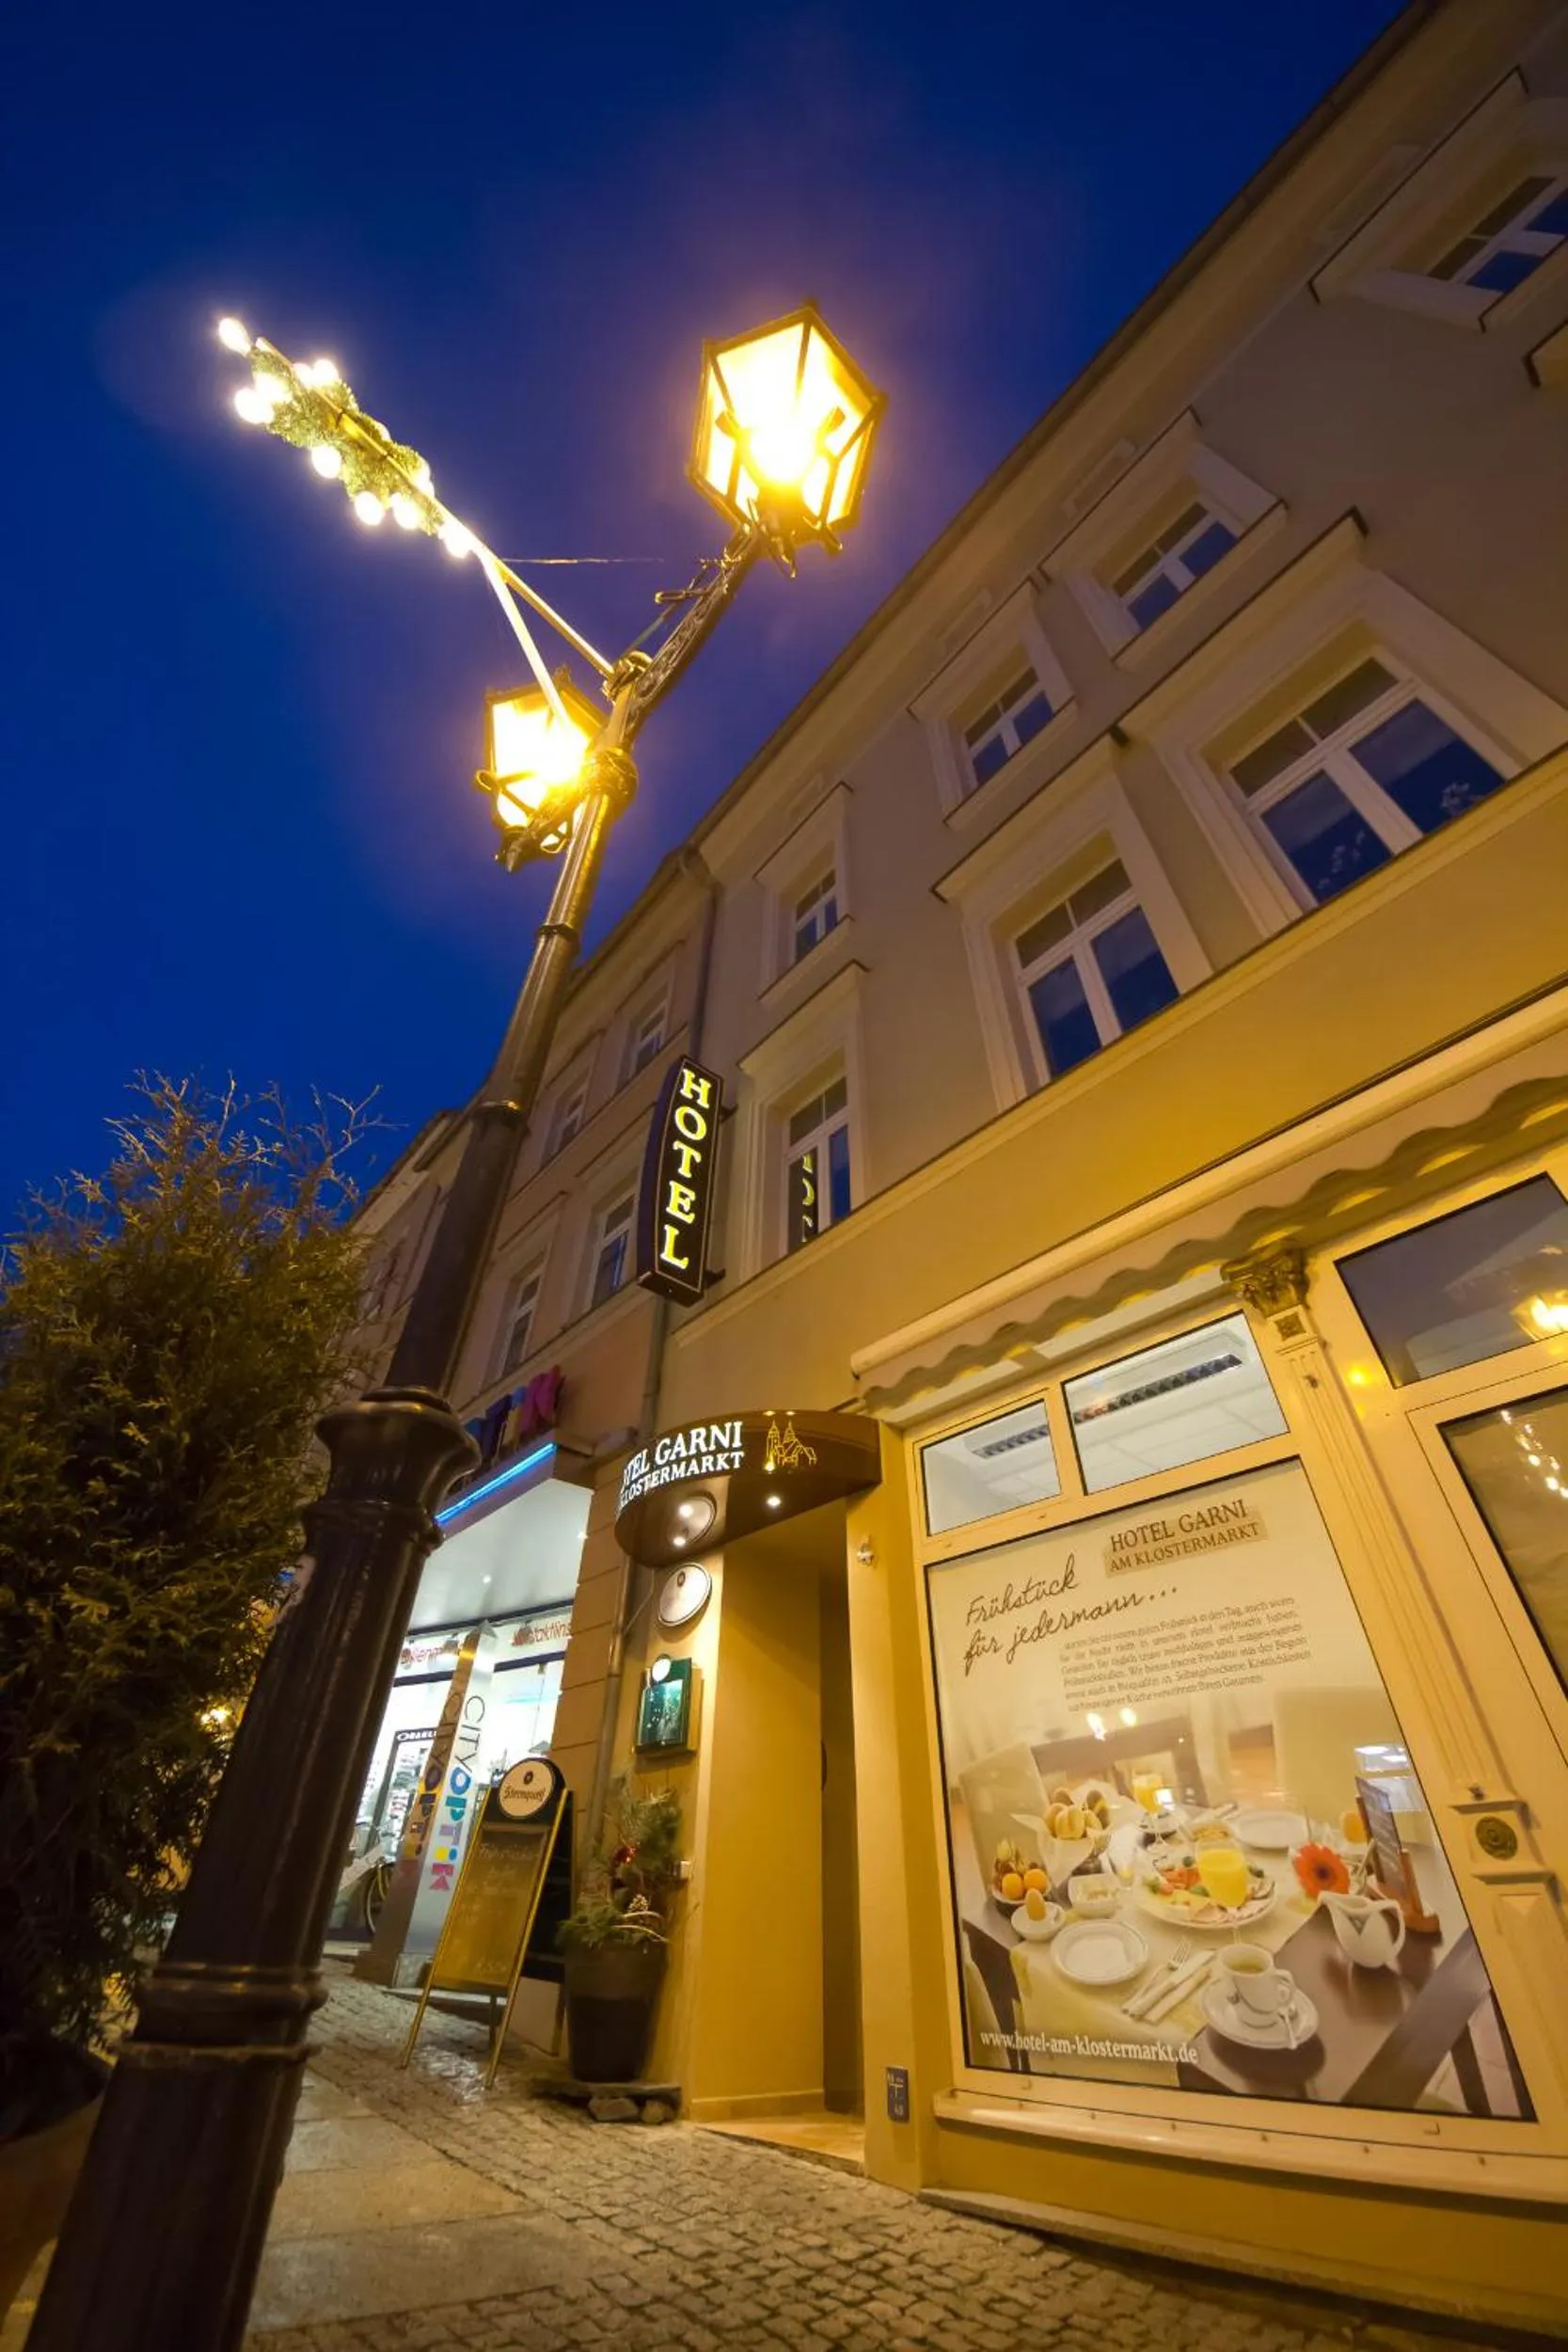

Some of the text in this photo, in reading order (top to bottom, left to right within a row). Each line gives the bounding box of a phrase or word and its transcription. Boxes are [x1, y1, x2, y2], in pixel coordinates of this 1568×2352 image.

[659, 1068, 712, 1270] HOTEL
[655, 1421, 744, 1466] GARNI
[1109, 1522, 1260, 1573] AM KLOSTERMARKT
[1111, 1499, 1248, 1552] HOTEL GARNI
[965, 1553, 1080, 1627] Frühstück
[963, 1628, 1003, 1677] für
[980, 2029, 1198, 2064] www.hotel-am-klostermarkt.de
